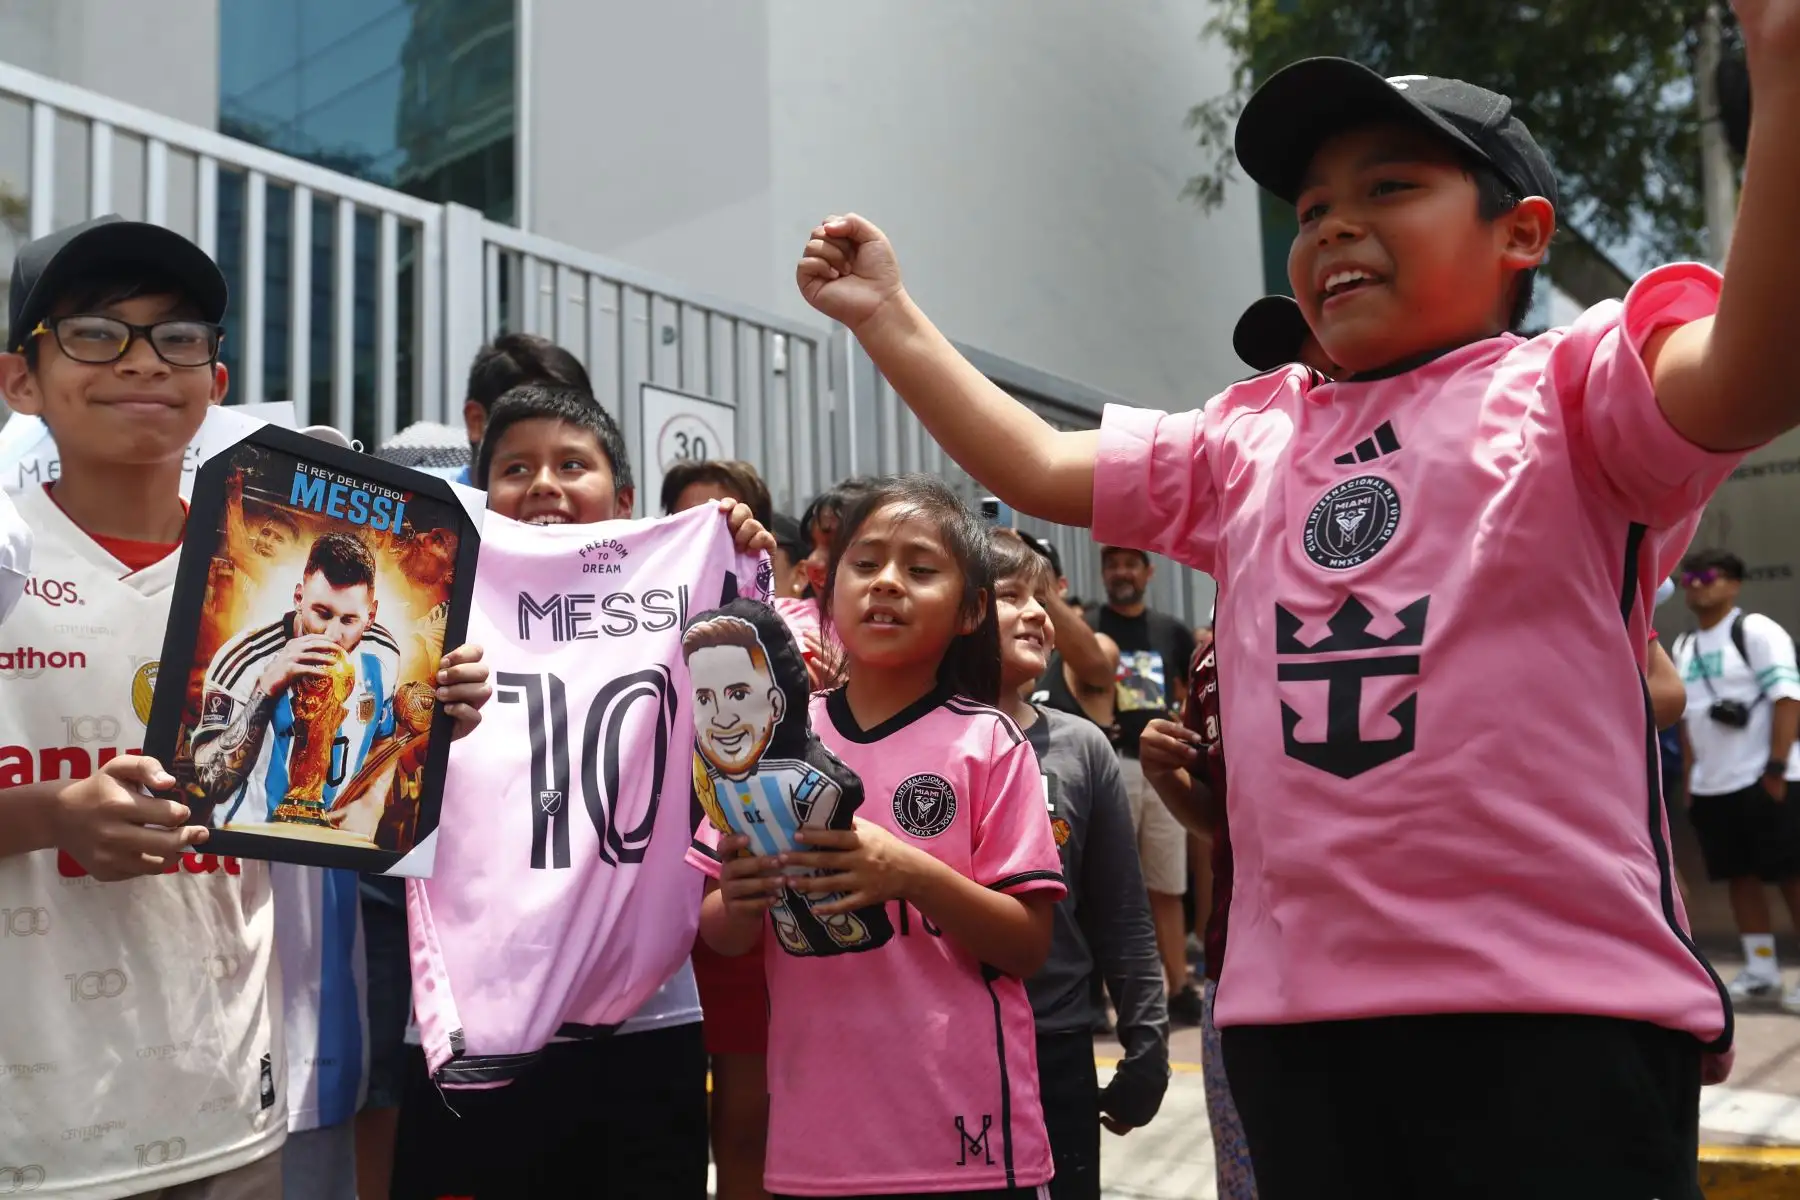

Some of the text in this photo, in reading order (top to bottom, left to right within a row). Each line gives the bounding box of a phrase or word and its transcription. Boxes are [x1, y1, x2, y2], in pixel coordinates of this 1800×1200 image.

[675, 431, 707, 461] 30
[310, 466, 334, 480] REY
[337, 474, 359, 489] DEL
[362, 482, 406, 503] FÚTBOL
[289, 471, 405, 535] MESSI
[1335, 496, 1372, 510] MIAMI
[579, 538, 629, 559] FREEDOM
[597, 552, 609, 560] TO
[1329, 555, 1361, 567] MMXX
[582, 563, 621, 574] DREAM
[518, 584, 688, 642] MESSI
[61, 714, 121, 746] 100
[496, 663, 678, 870] 10
[914, 787, 939, 798] MIAMI
[2, 906, 50, 938] 100
[65, 968, 127, 1003] 100
[134, 1136, 187, 1169] 100
